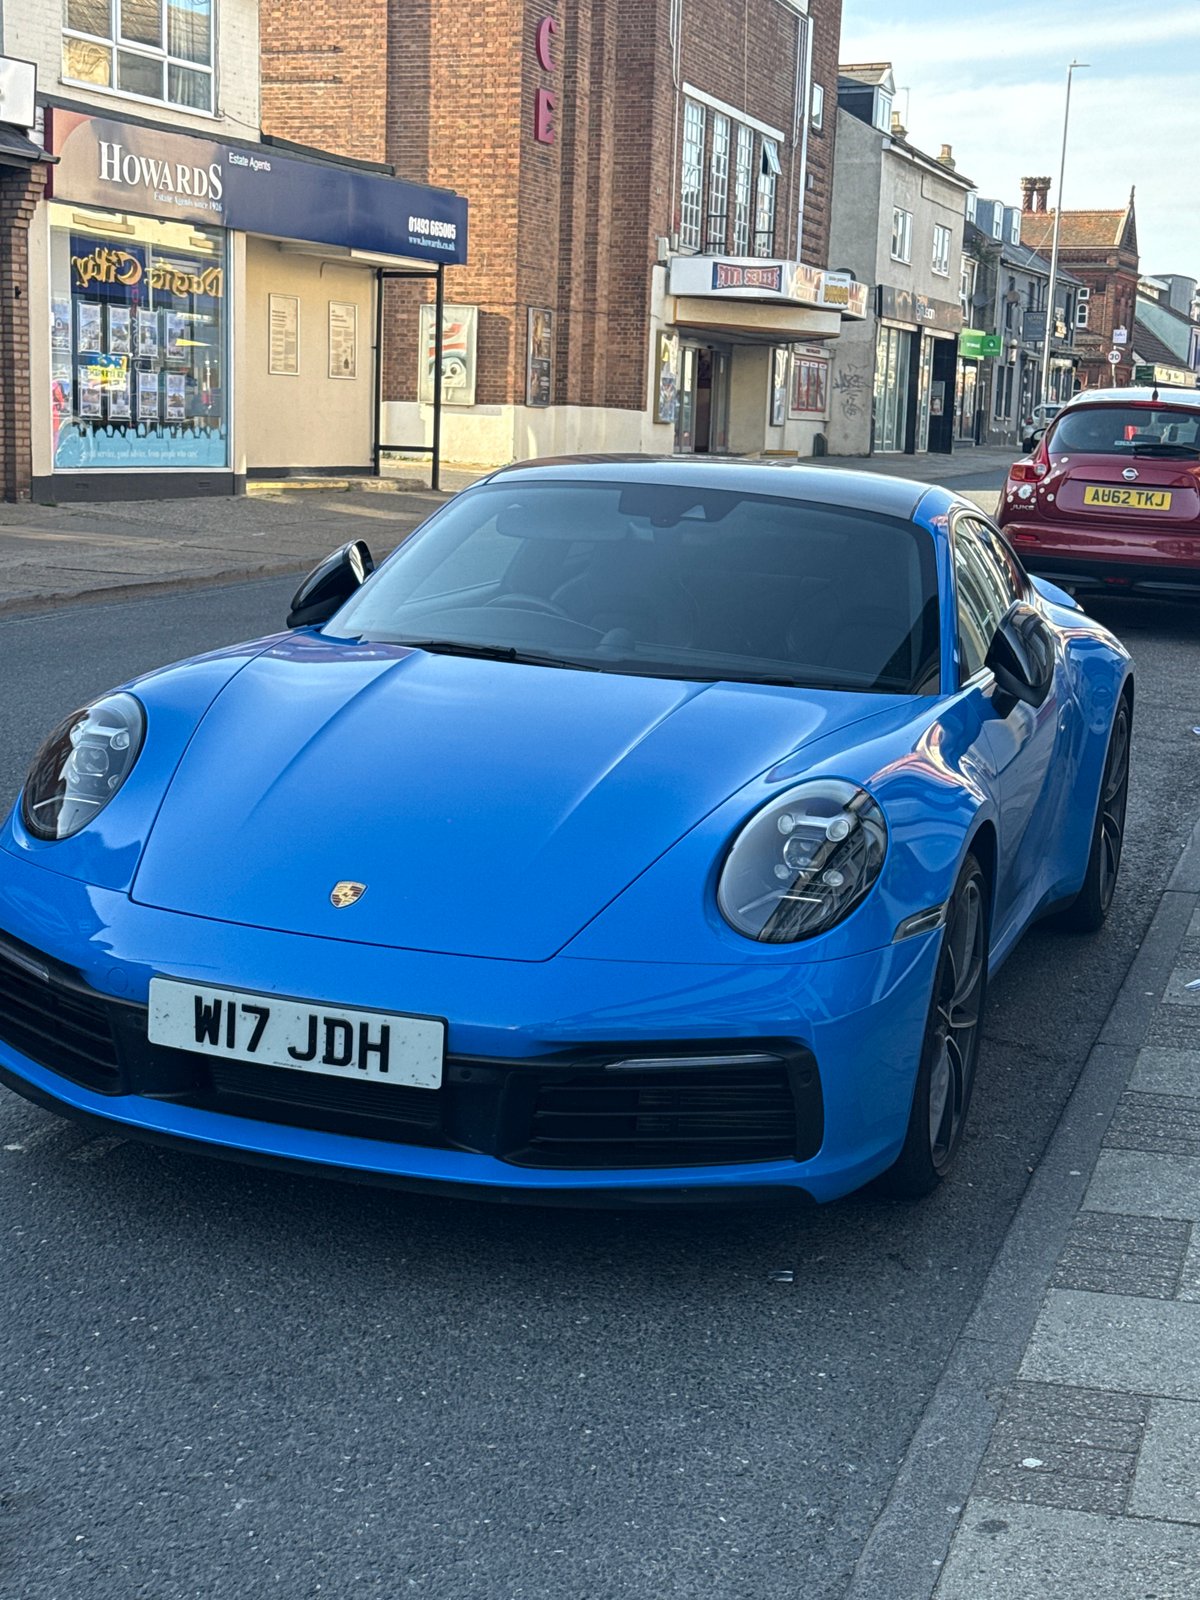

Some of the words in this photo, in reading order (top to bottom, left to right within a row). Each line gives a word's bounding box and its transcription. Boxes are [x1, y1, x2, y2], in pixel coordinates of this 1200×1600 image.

[99, 140, 223, 201] HOWARDS
[228, 152, 249, 167] Estate
[249, 157, 271, 172] Agents
[408, 215, 430, 235] 01493
[717, 264, 743, 288] FOUR
[1110, 353, 1120, 361] 30
[1010, 503, 1035, 511] JUKE
[1091, 489, 1131, 505] AU62
[1136, 492, 1165, 507] TKJ
[194, 995, 270, 1053] W17
[287, 1014, 391, 1073] JDH
